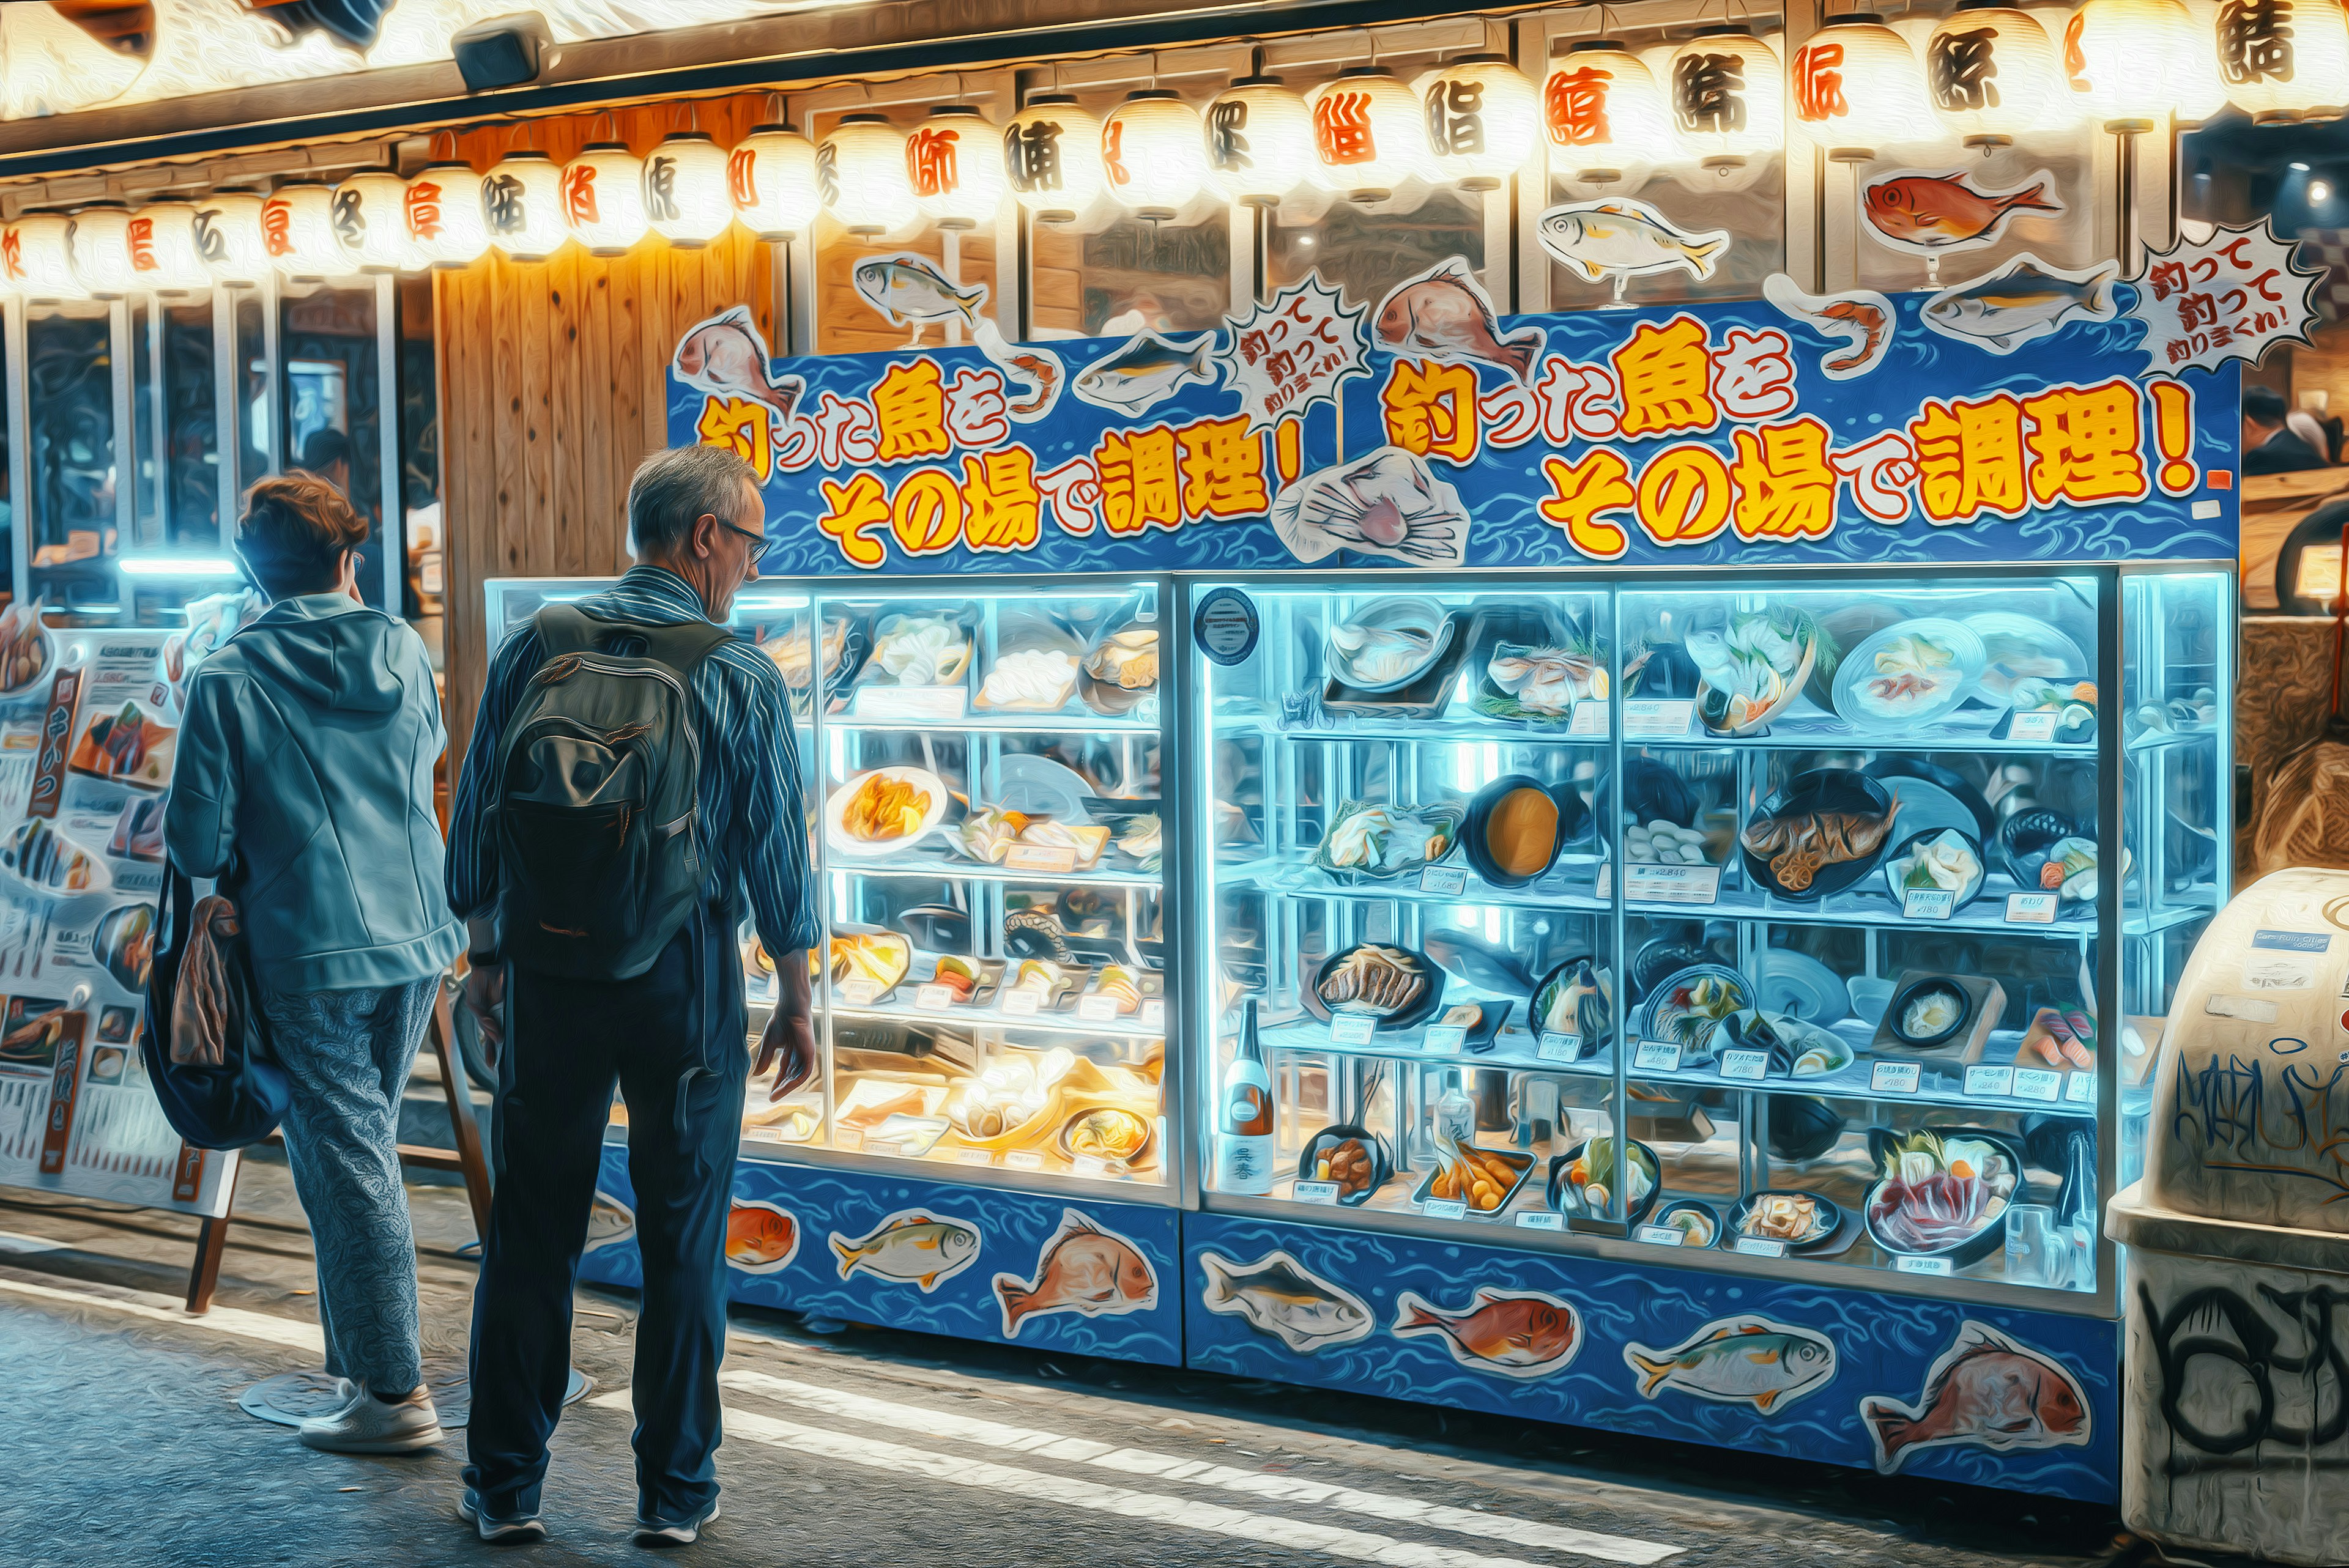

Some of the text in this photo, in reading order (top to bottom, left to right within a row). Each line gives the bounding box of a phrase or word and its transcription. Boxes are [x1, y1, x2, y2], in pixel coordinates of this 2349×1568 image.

[2149, 237, 2254, 301] 釣って
[2177, 268, 2282, 333] 釣って
[1241, 296, 1312, 366] 釣って
[1266, 317, 1339, 386] 釣って
[697, 352, 1011, 487] 釣った魚を
[1377, 311, 1800, 468] 釣った魚を
[1538, 375, 2200, 559] その場で調理!
